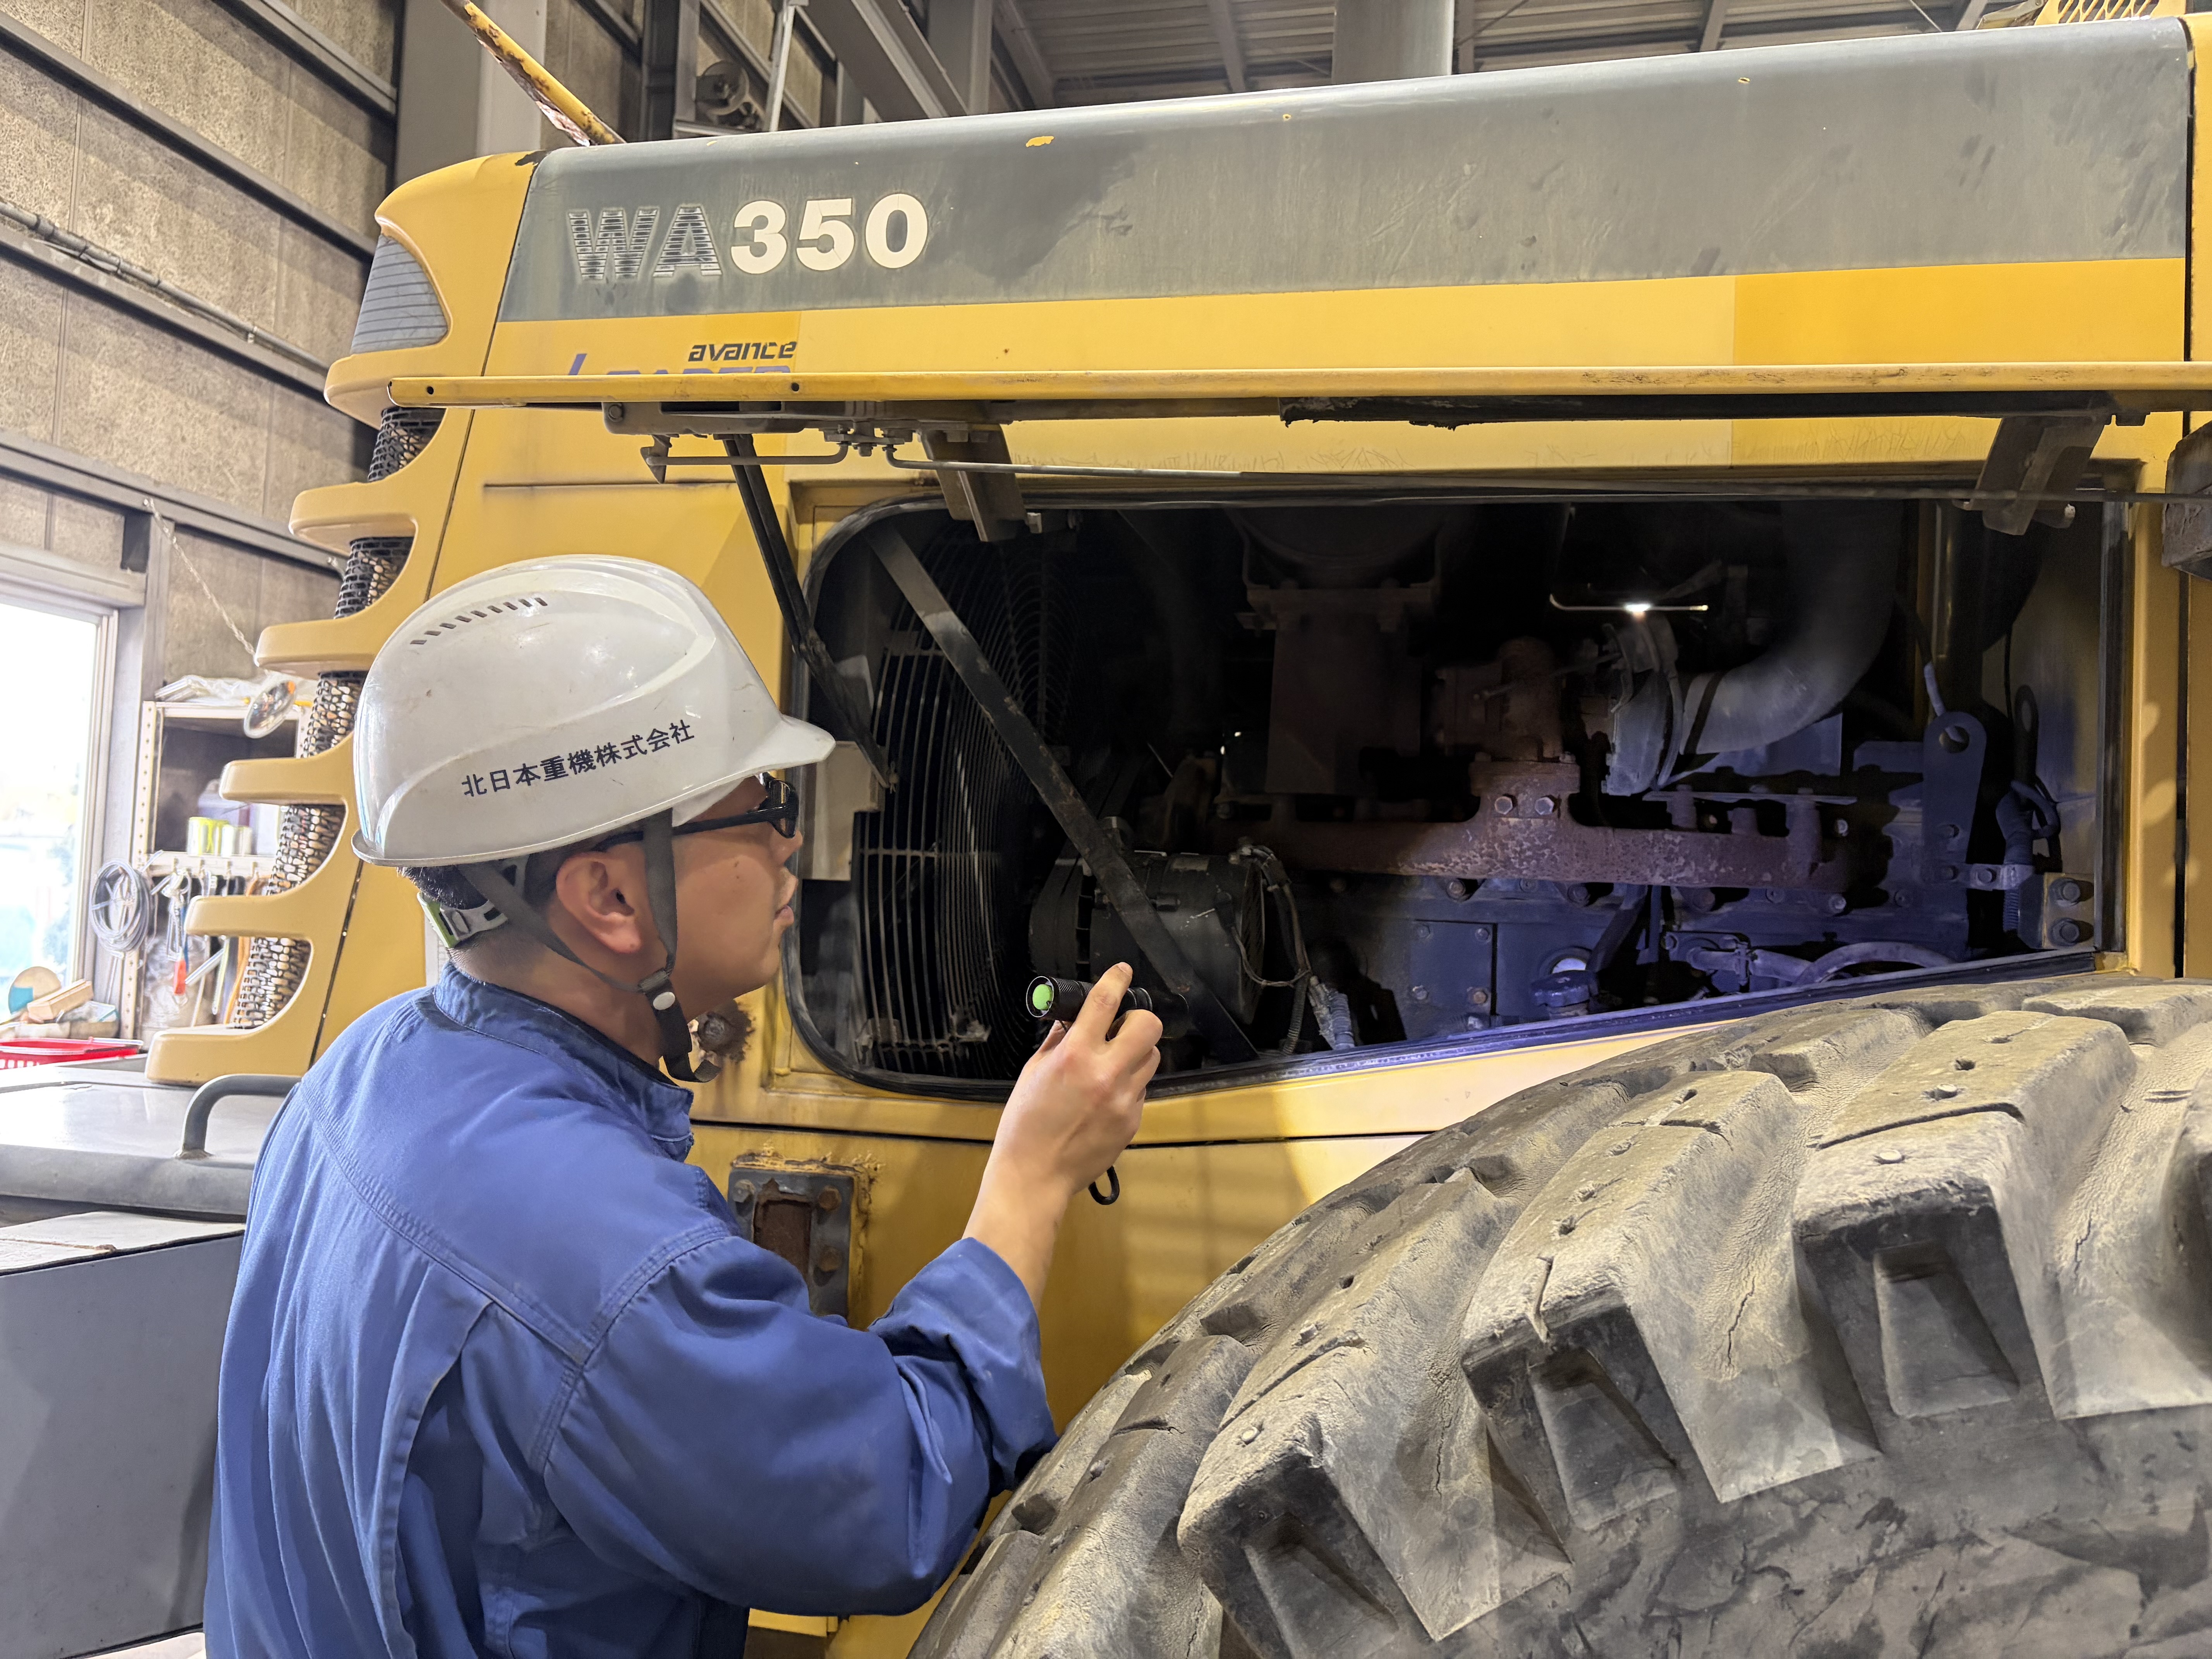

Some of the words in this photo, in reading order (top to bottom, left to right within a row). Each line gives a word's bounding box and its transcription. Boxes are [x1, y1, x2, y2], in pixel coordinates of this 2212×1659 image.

[568, 193, 928, 280] WA350
[688, 341, 797, 362] avance
[462, 720, 694, 797] 北日本重機株式会社
